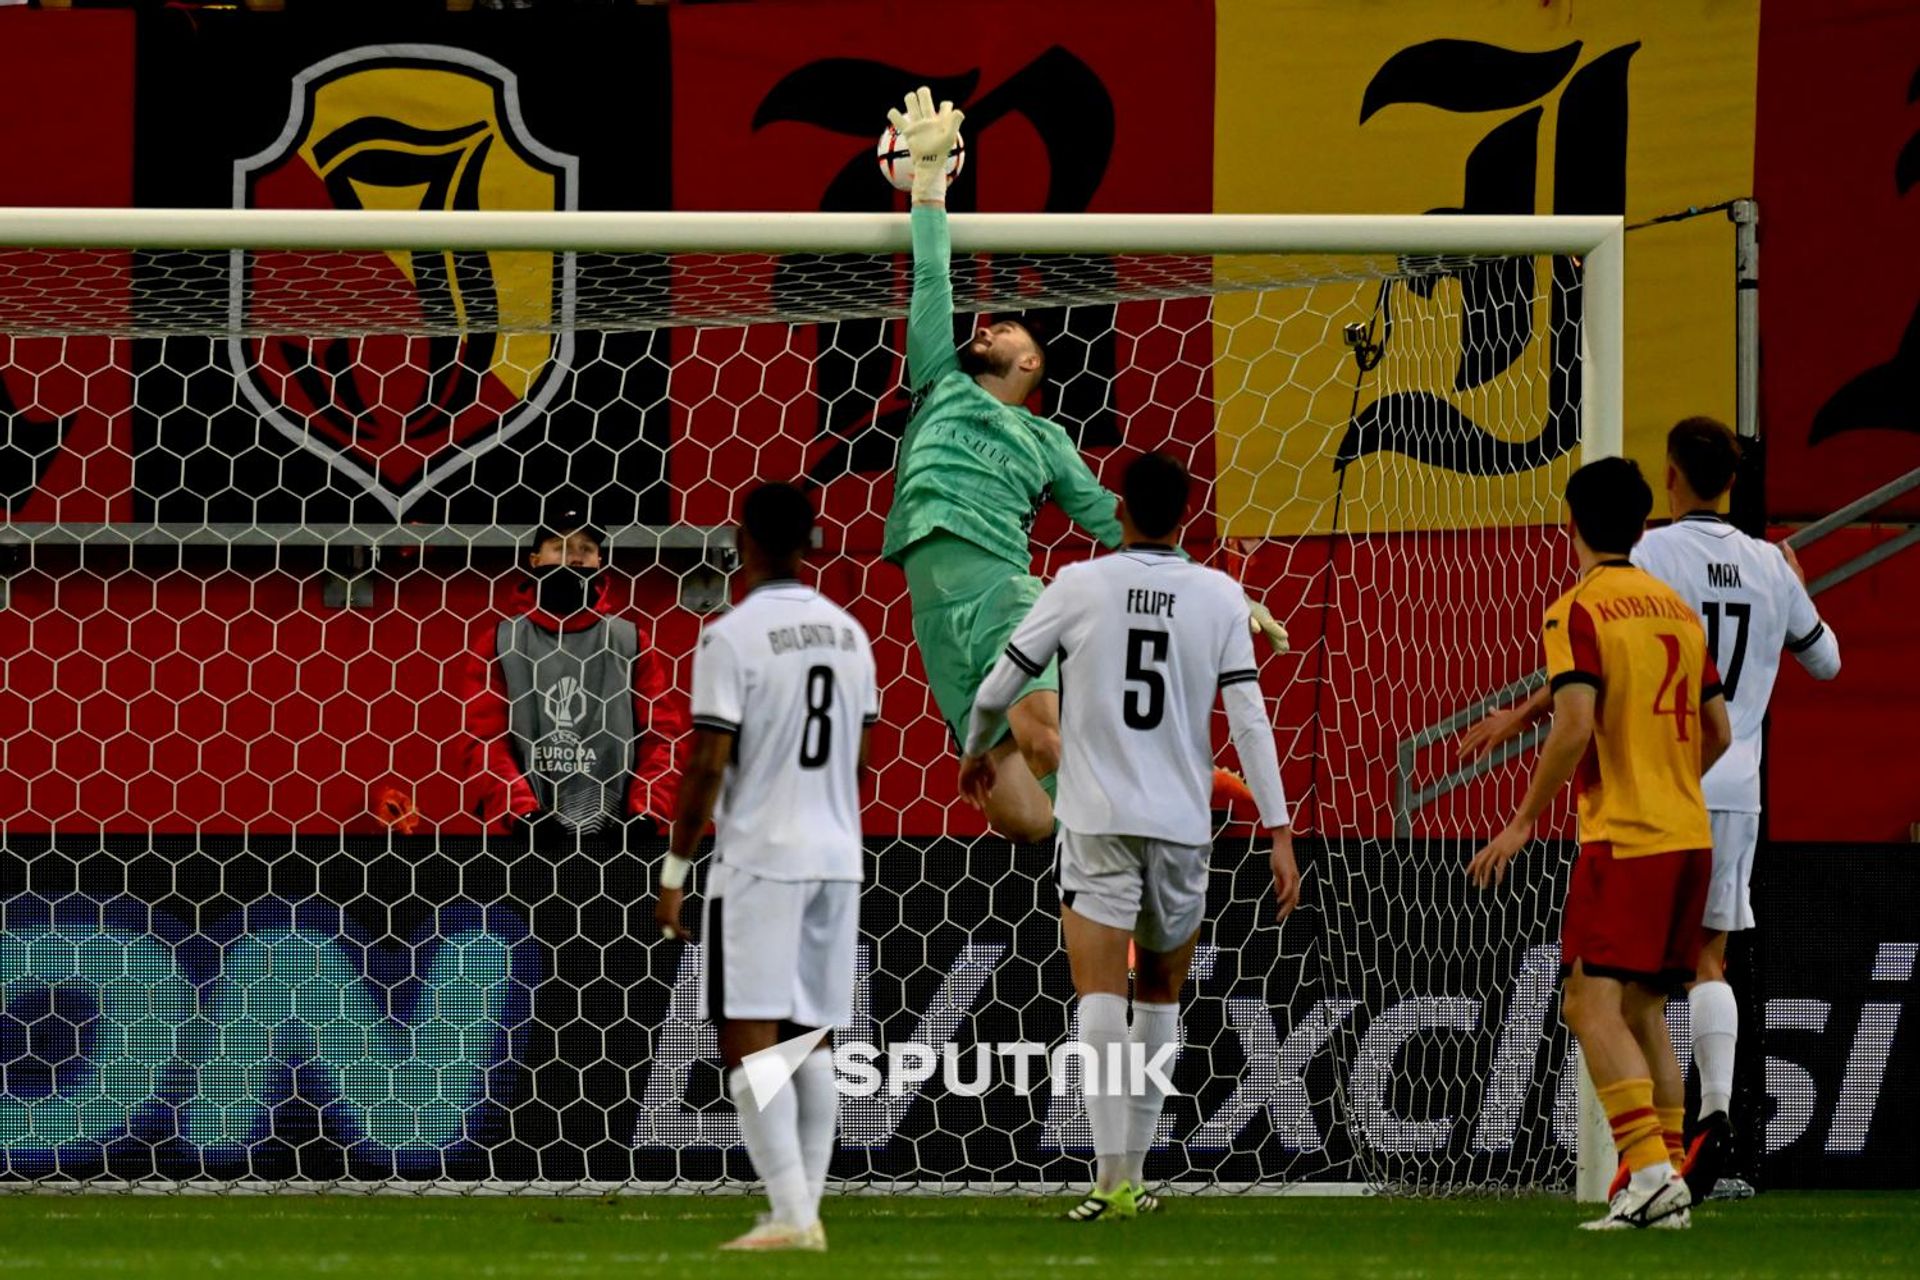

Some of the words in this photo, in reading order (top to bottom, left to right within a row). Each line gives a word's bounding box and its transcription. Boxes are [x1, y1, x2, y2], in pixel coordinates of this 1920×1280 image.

[1127, 588, 1176, 618] FELIPE
[1707, 563, 1742, 588] MAX
[1123, 628, 1169, 731] 5
[1702, 602, 1751, 702] 17
[798, 665, 833, 770] 8
[1653, 634, 1697, 742] 4
[533, 746, 597, 761] EUROPA
[539, 761, 592, 773] LEAGUE
